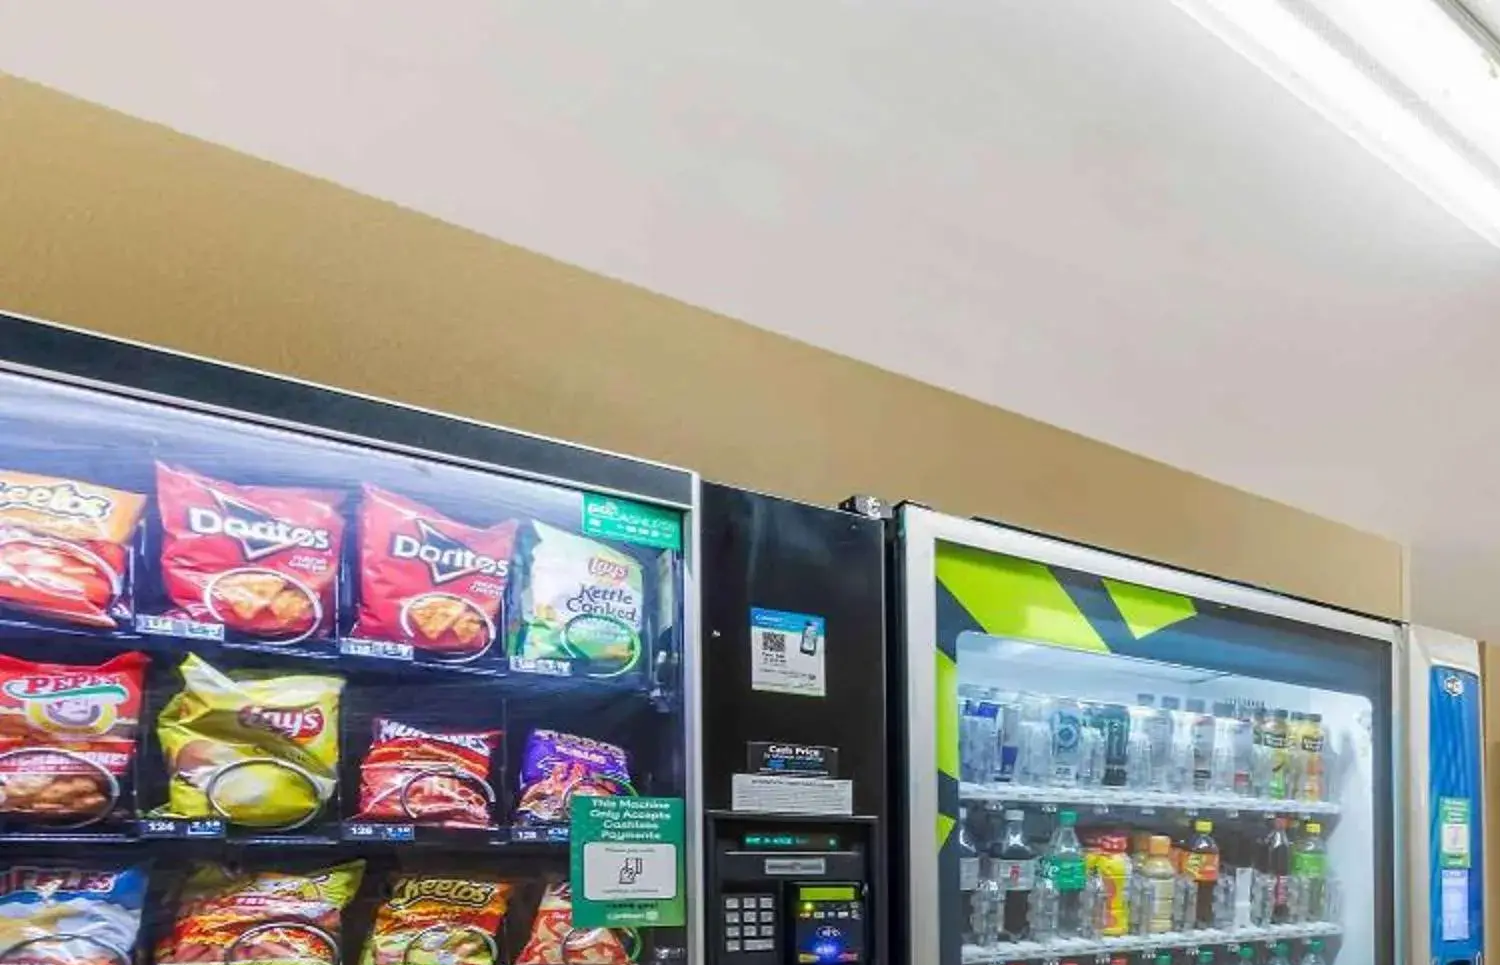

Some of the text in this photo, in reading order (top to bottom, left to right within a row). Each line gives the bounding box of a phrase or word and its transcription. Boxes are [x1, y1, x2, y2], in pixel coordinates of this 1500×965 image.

[188, 507, 330, 550] Doritos
[395, 534, 509, 578] Doritos
[577, 583, 633, 606] Kettle
[566, 597, 638, 622] Cooked
[590, 809, 671, 821] Only Accepts
[592, 798, 670, 810] This Machine
[600, 829, 660, 841] Payments
[388, 878, 494, 906] Cheetos
